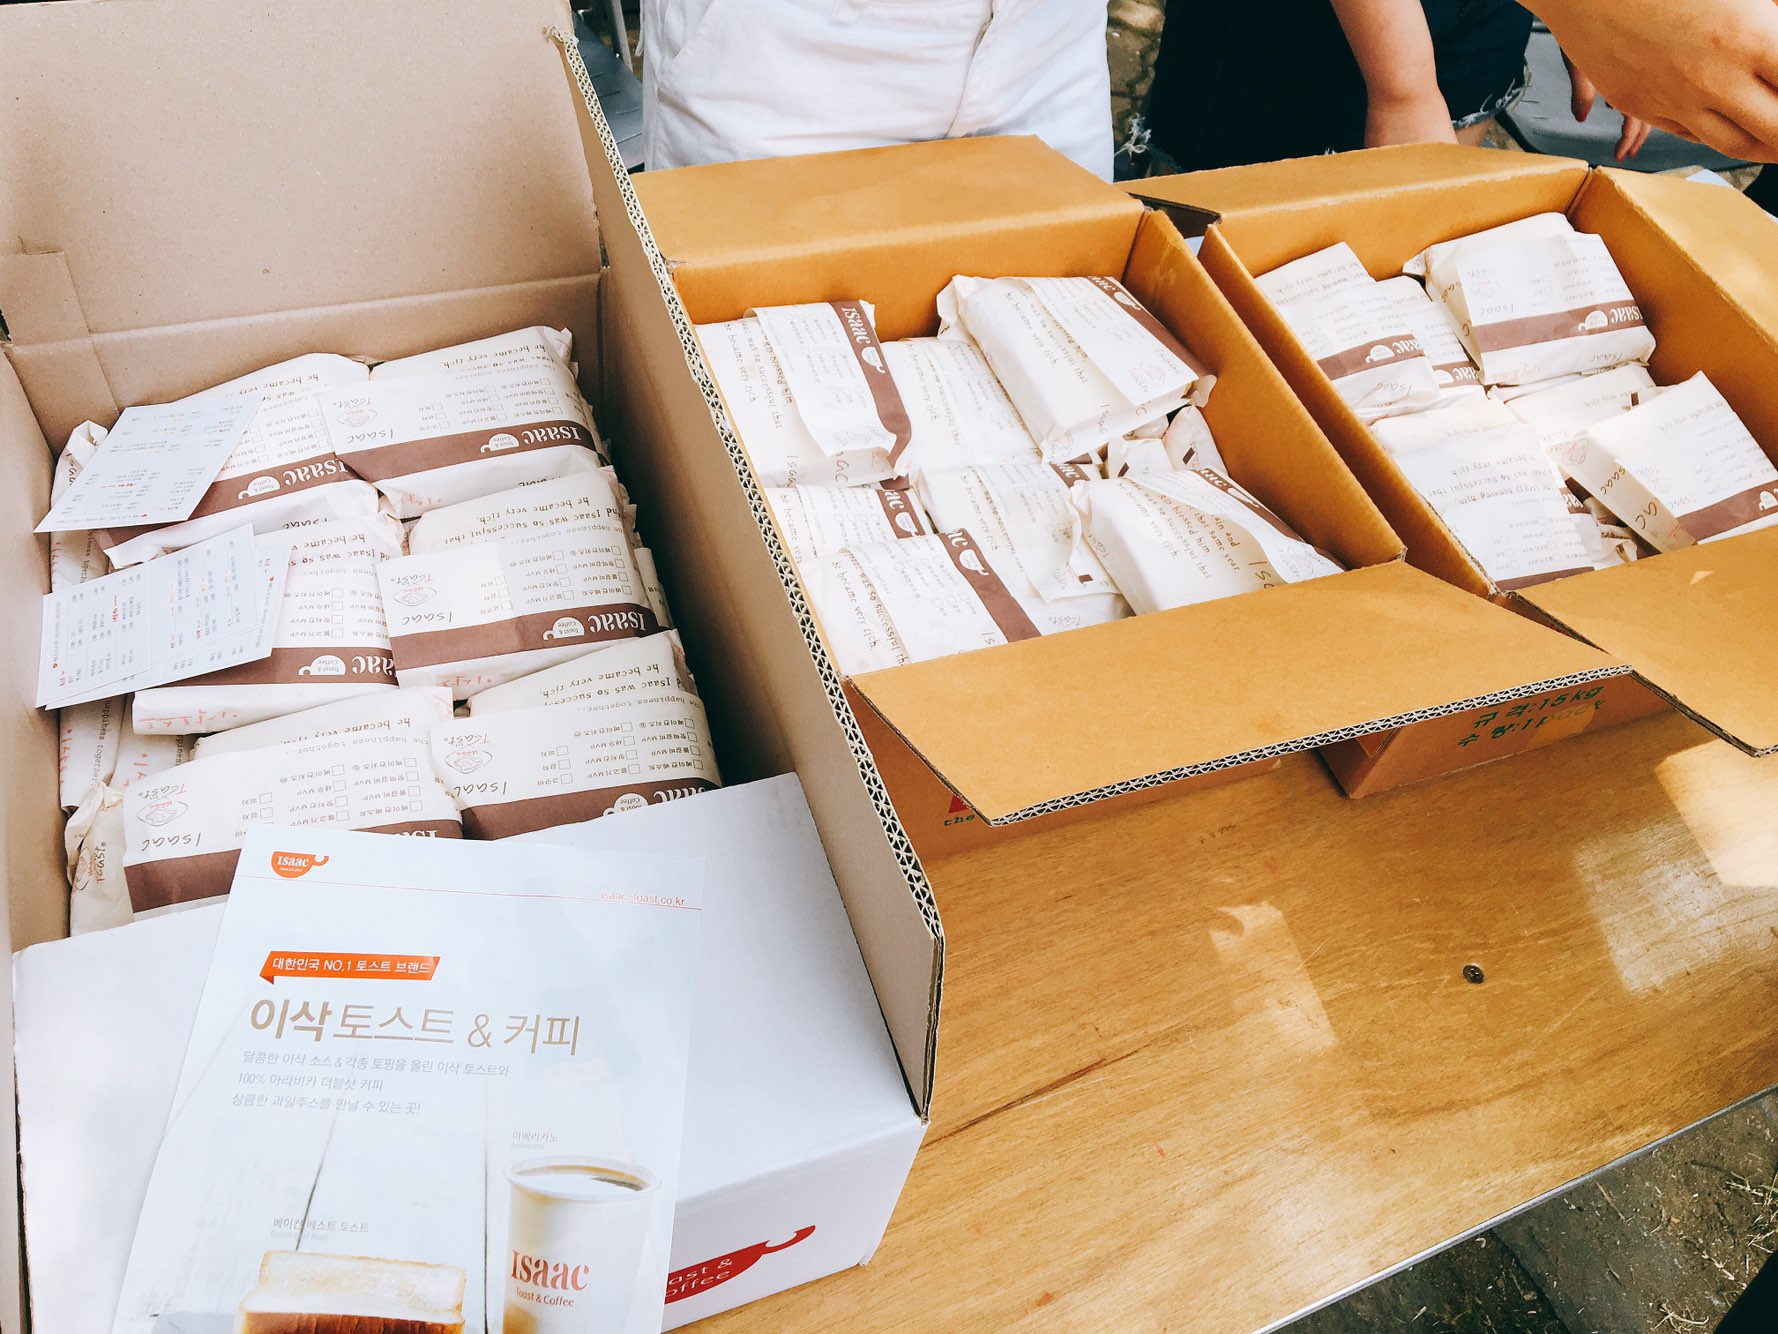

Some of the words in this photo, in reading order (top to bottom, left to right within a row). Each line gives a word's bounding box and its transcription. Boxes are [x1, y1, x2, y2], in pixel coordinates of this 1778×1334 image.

[1479, 303, 1514, 316] Isaac
[841, 302, 871, 348] Isaac
[494, 345, 530, 357] became
[533, 344, 546, 353] he
[466, 352, 488, 363] very
[728, 334, 743, 363] became
[737, 366, 750, 382] very
[263, 376, 302, 389] became
[305, 373, 319, 382] he
[347, 428, 394, 444] Isaac
[521, 424, 580, 445] Isaac
[282, 457, 347, 485] Isaac
[534, 499, 572, 512] became
[576, 496, 589, 507] he
[505, 504, 527, 517] very
[574, 509, 600, 520] Isaac
[549, 516, 568, 525] was
[1172, 503, 1198, 537] blessed
[1194, 509, 1209, 529] that
[1206, 527, 1227, 552] same
[303, 535, 346, 548] became
[352, 533, 365, 543] he
[1225, 530, 1240, 549] and
[346, 548, 374, 558] Isaac
[1167, 517, 1199, 560] successful
[1196, 559, 1211, 580] that
[319, 553, 340, 562] was
[837, 571, 857, 603] became
[851, 605, 867, 626] very
[402, 611, 452, 626] Isaac
[858, 572, 872, 589] was
[868, 590, 877, 602] so
[875, 603, 901, 651] successful
[587, 609, 645, 633] Isaac
[598, 666, 640, 680] became
[646, 663, 659, 673] he
[569, 677, 591, 687] very
[344, 720, 391, 733] became
[395, 717, 410, 728] he
[140, 832, 201, 852] Isaac
[277, 855, 309, 866] Isaac
[272, 956, 320, 972] 대한민국
[323, 959, 352, 971] NO.1
[355, 960, 390, 972] 토스트
[394, 961, 431, 974] 브랜드
[466, 1012, 494, 1049] &
[502, 1011, 580, 1056] 커피
[242, 1049, 279, 1066] 달콤한
[282, 1052, 306, 1067] 이삭
[371, 1057, 405, 1072] 토핑을
[436, 1061, 460, 1075] 이삭
[462, 1062, 509, 1078] 토스트와
[238, 1071, 265, 1084] 100%
[269, 1073, 316, 1089] 아라비카
[320, 1076, 356, 1090] 더블샷
[359, 1077, 383, 1092] 커피
[362, 1100, 375, 1112] 수
[377, 1100, 402, 1114] 있는
[511, 1130, 559, 1143] 아메리카노
[338, 1221, 368, 1232] 토스트
[509, 1249, 590, 1292] Isaac
[663, 1271, 730, 1297] offee
[515, 1287, 534, 1301] Toast
[543, 1294, 574, 1307] Coffee
